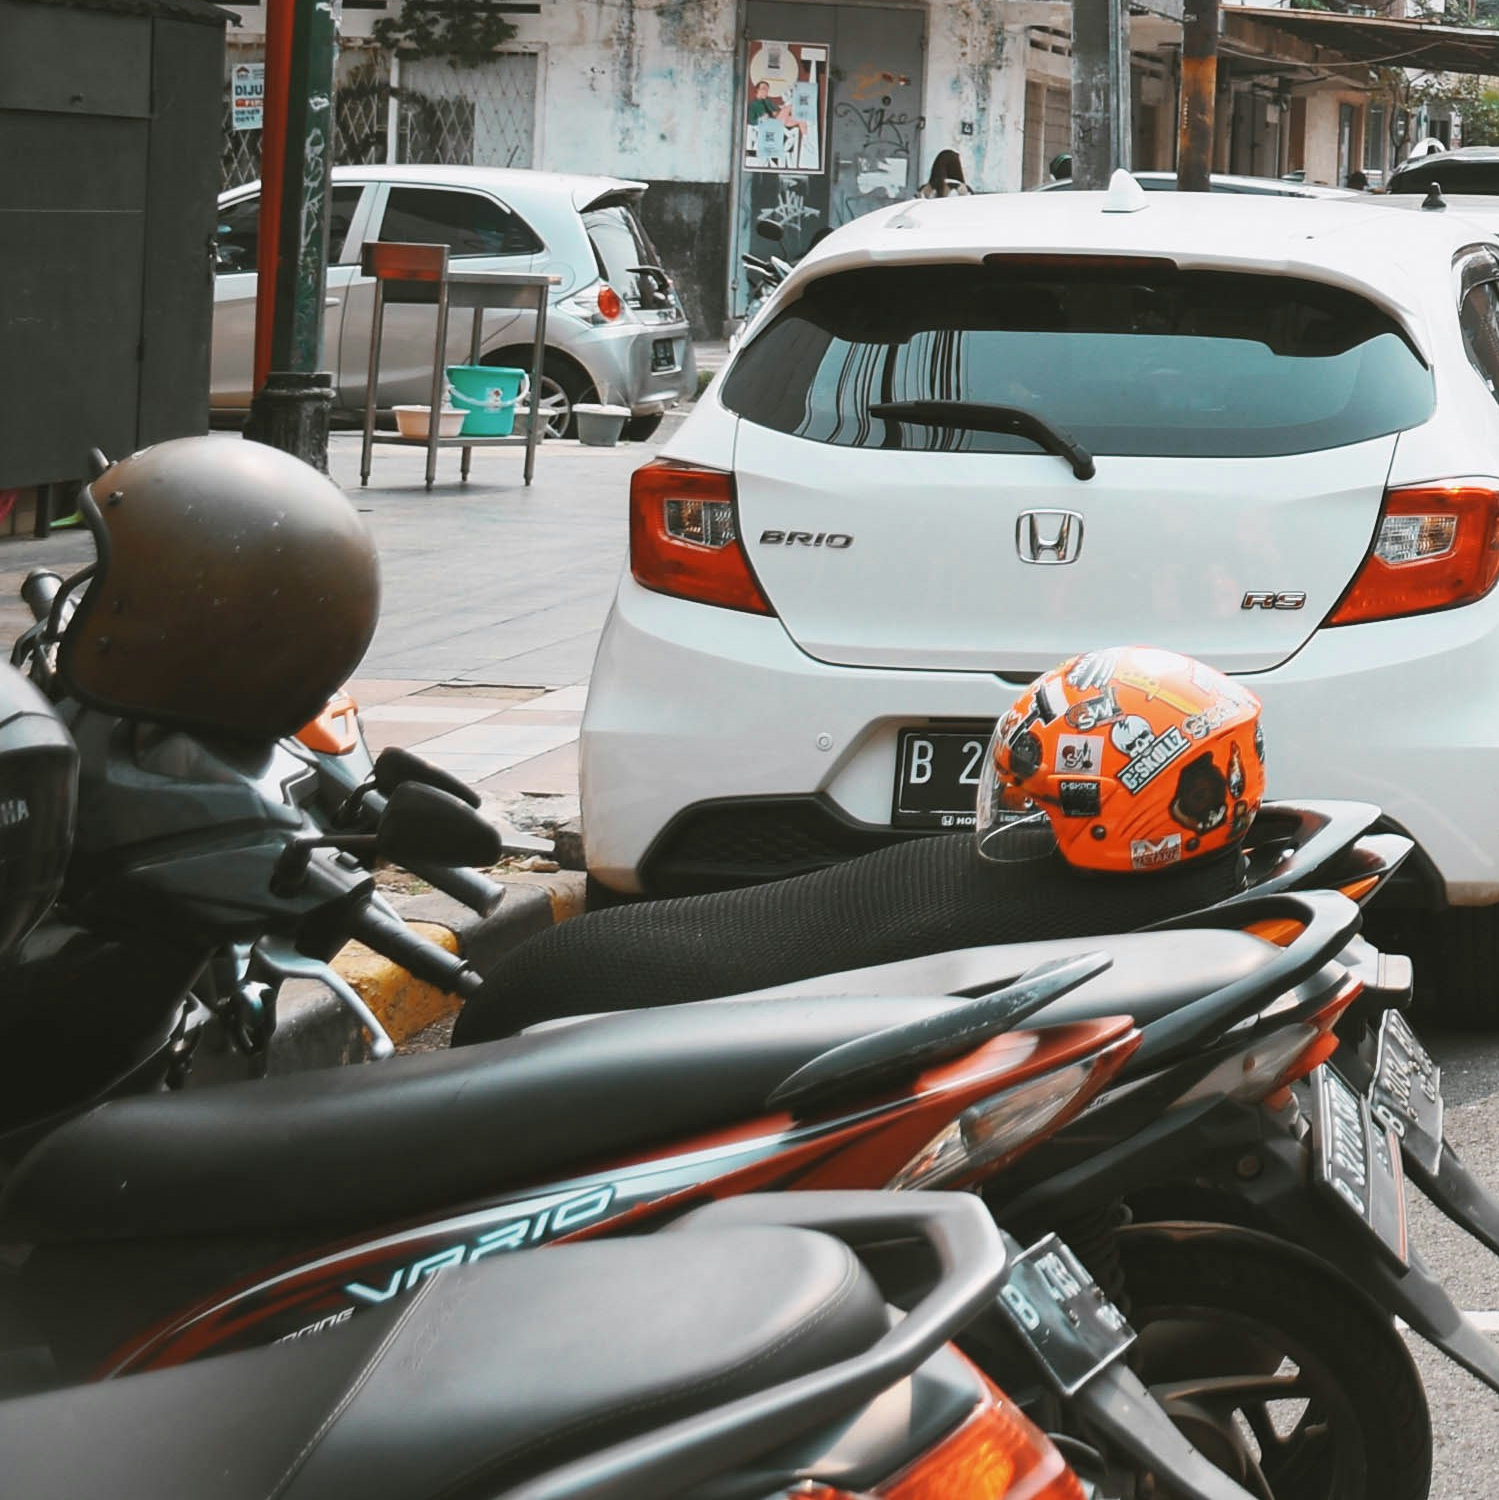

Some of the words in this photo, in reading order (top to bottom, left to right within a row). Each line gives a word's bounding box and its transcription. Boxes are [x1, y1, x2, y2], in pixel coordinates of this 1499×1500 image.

[759, 529, 855, 550] BRIO
[1239, 590, 1307, 611] RS
[909, 740, 934, 784] B
[346, 1183, 617, 1303] VARIO
[1001, 1283, 1041, 1332] B
